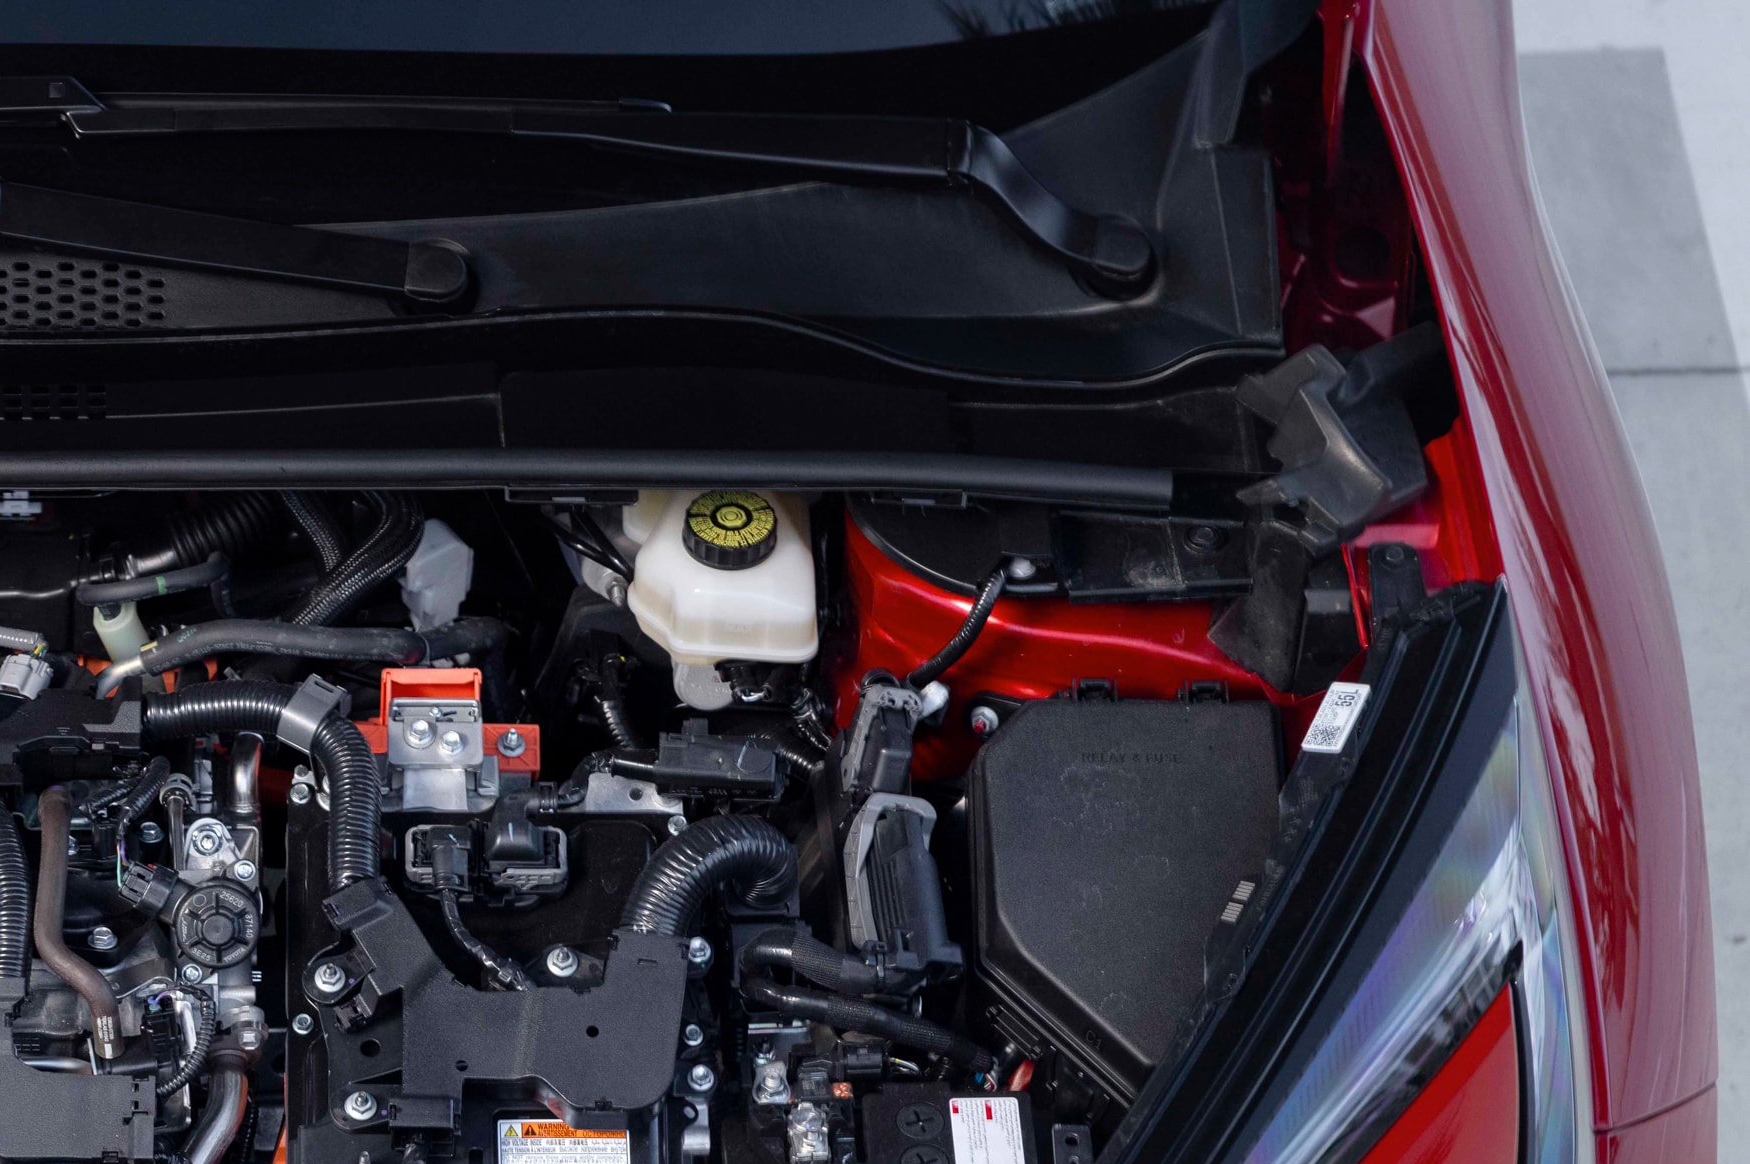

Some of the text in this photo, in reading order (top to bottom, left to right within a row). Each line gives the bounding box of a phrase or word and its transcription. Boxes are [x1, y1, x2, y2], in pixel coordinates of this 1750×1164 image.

[1335, 689, 1359, 707] 55L
[219, 890, 244, 908] 25620
[244, 914, 254, 938] 37140
[191, 947, 212, 961] 3E25
[223, 947, 247, 963] TOYOTA
